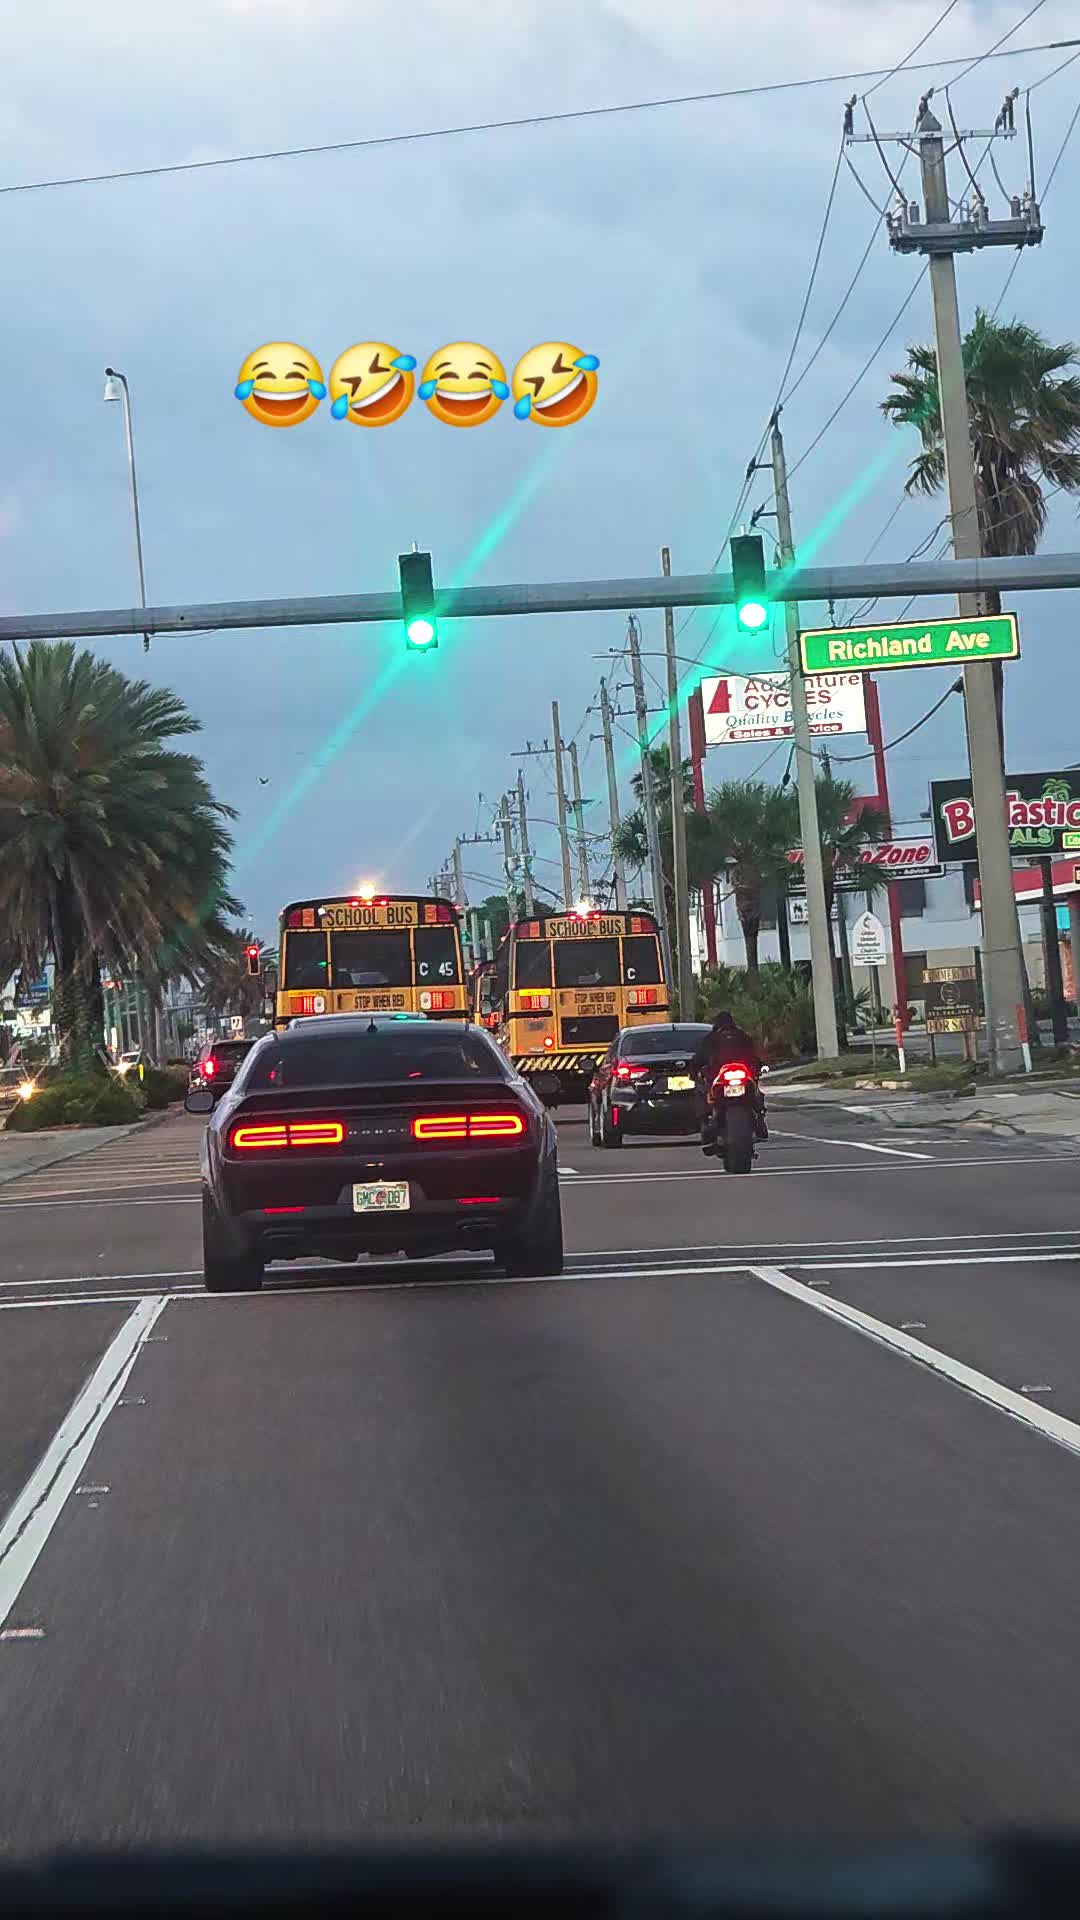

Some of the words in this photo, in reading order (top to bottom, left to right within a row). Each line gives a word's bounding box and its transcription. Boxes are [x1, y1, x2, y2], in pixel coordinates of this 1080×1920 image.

[828, 633, 932, 661] Richland
[945, 630, 990, 651] Ave
[744, 689, 833, 710] CYCES
[726, 713, 779, 728] Quality
[733, 729, 771, 739] Sales
[327, 907, 379, 926] SCHOOL
[387, 906, 413, 924] BUS
[549, 920, 593, 937] SCHOOL
[599, 919, 622, 934] BUS
[419, 962, 429, 976] C
[438, 961, 454, 977] 45
[626, 967, 636, 980] C
[355, 994, 371, 1009] STOP
[372, 994, 391, 1008] WHEN
[392, 993, 405, 1007] RED
